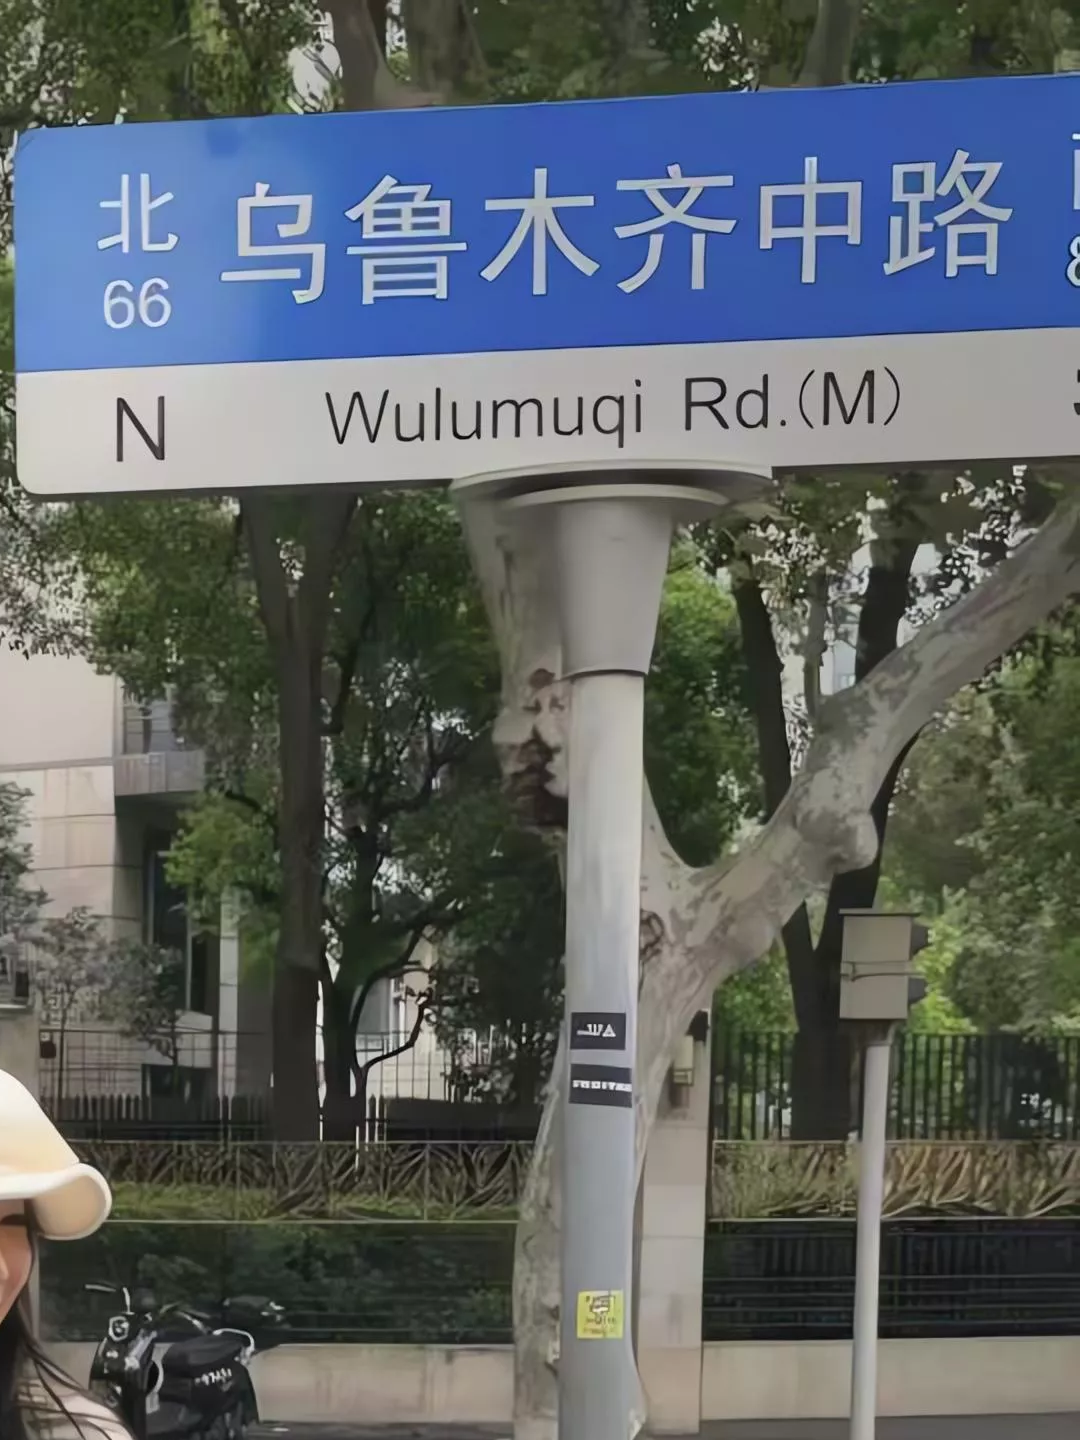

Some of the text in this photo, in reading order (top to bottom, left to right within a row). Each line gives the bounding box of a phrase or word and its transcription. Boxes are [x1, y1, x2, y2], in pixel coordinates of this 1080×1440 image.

[98, 173, 178, 254] 北
[220, 148, 1014, 305] 乌鲁木齐中路
[103, 277, 172, 329] 66
[116, 395, 166, 463] N
[325, 366, 902, 449] Wulumuqi Rd.(M)
